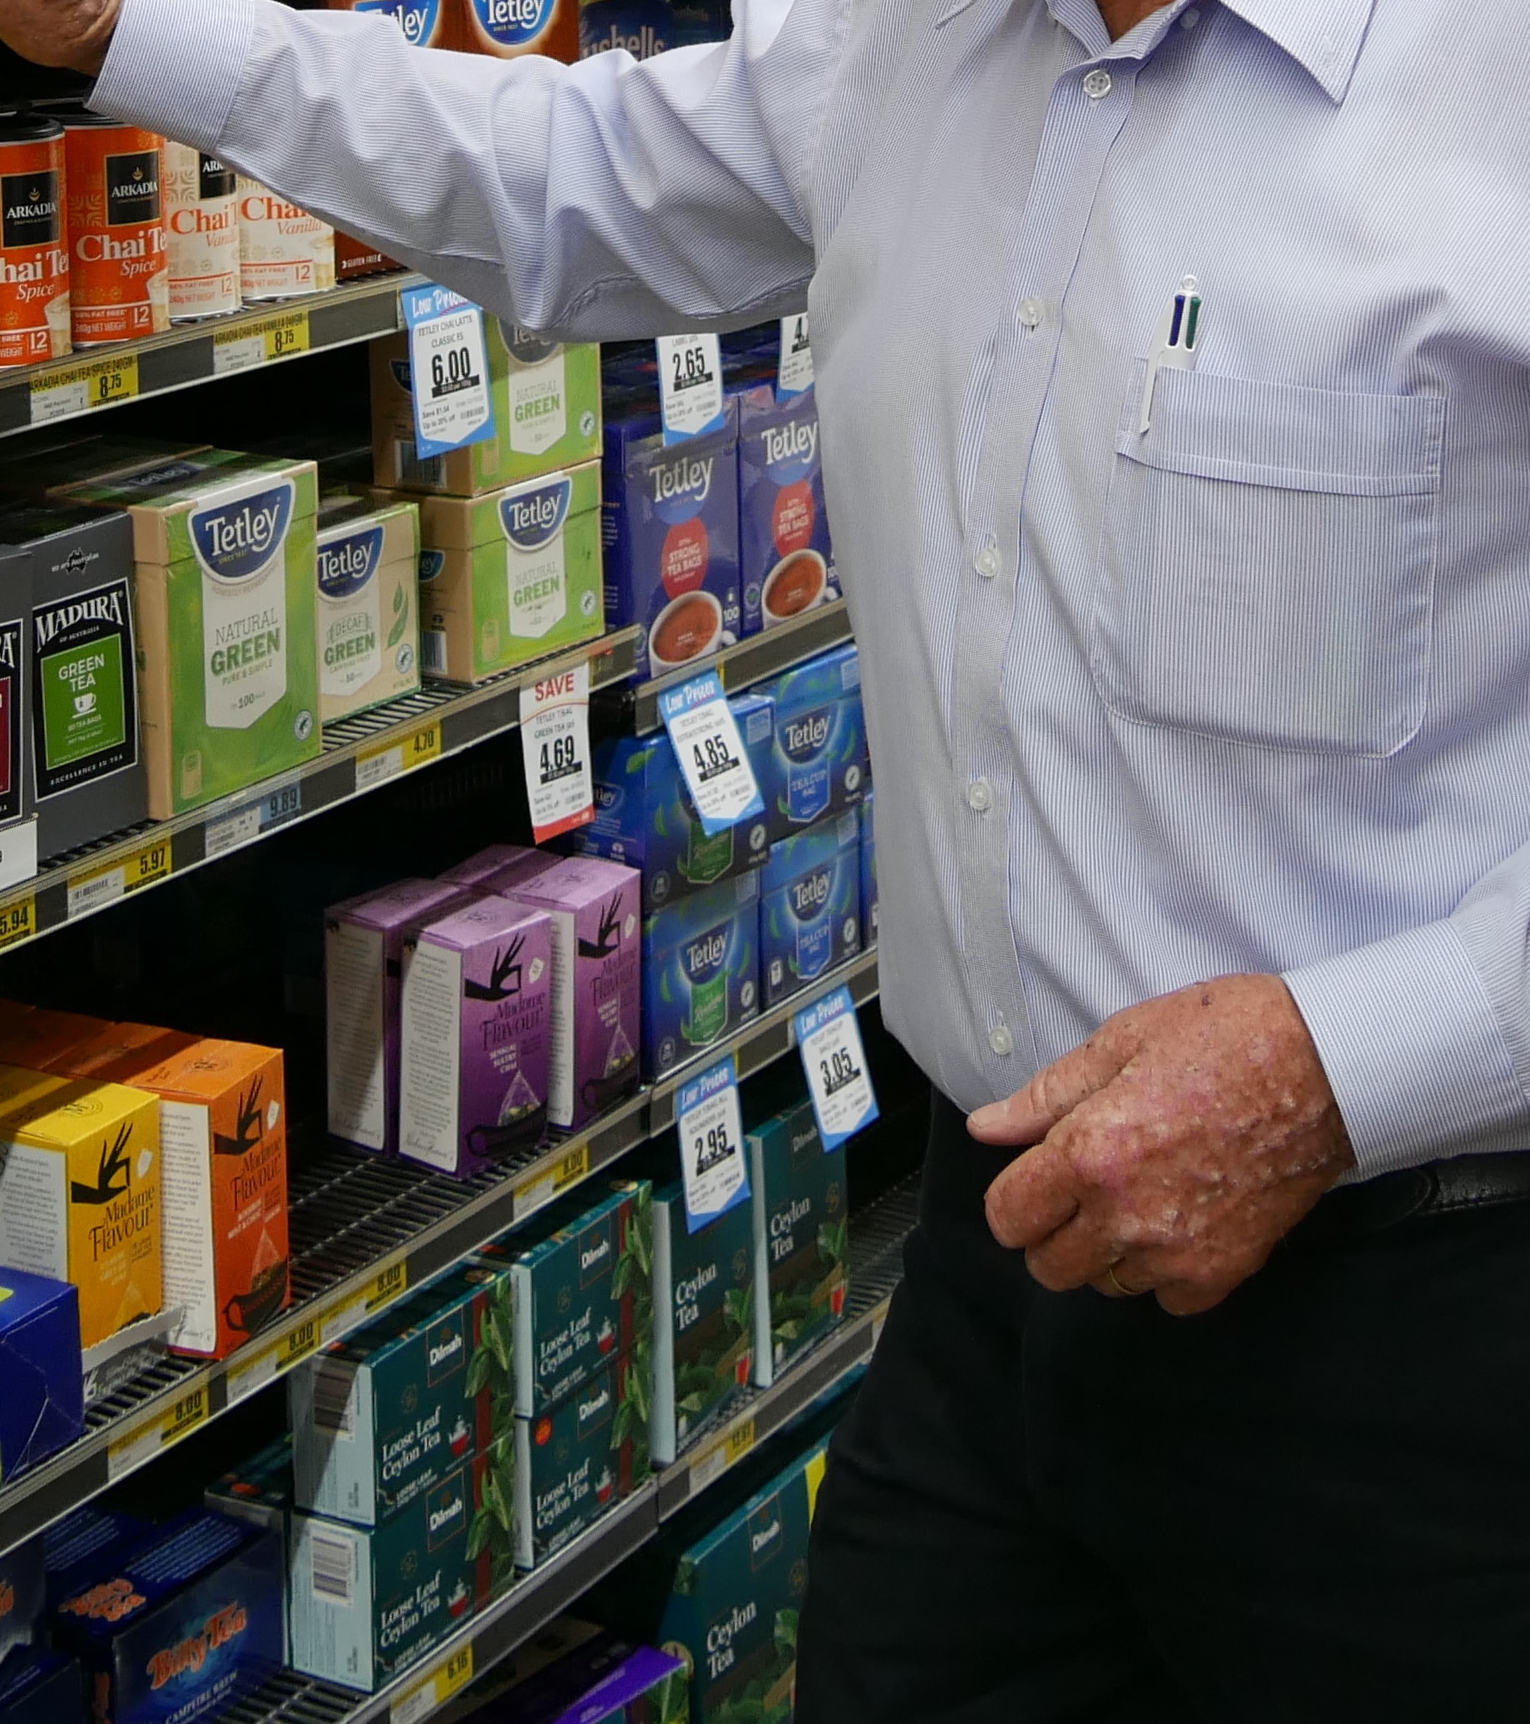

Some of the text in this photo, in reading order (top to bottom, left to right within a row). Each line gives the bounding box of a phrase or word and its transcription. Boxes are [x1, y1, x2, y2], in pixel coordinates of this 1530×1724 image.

[7, 201, 57, 220] ARKADIA
[77, 232, 136, 262] Chai
[430, 346, 471, 383] 6.00
[672, 346, 705, 377] 2.65
[98, 374, 122, 398] 8.75
[204, 500, 278, 560] Tetley
[214, 610, 279, 644] NATURAL
[210, 632, 281, 674] GREEN
[539, 737, 575, 767] 4.69
[690, 735, 730, 766] 4.85
[694, 1131, 730, 1170] 2.95
[383, 1406, 442, 1463] Loose Leaf
[382, 1433, 441, 1481] Ceylon Tea
